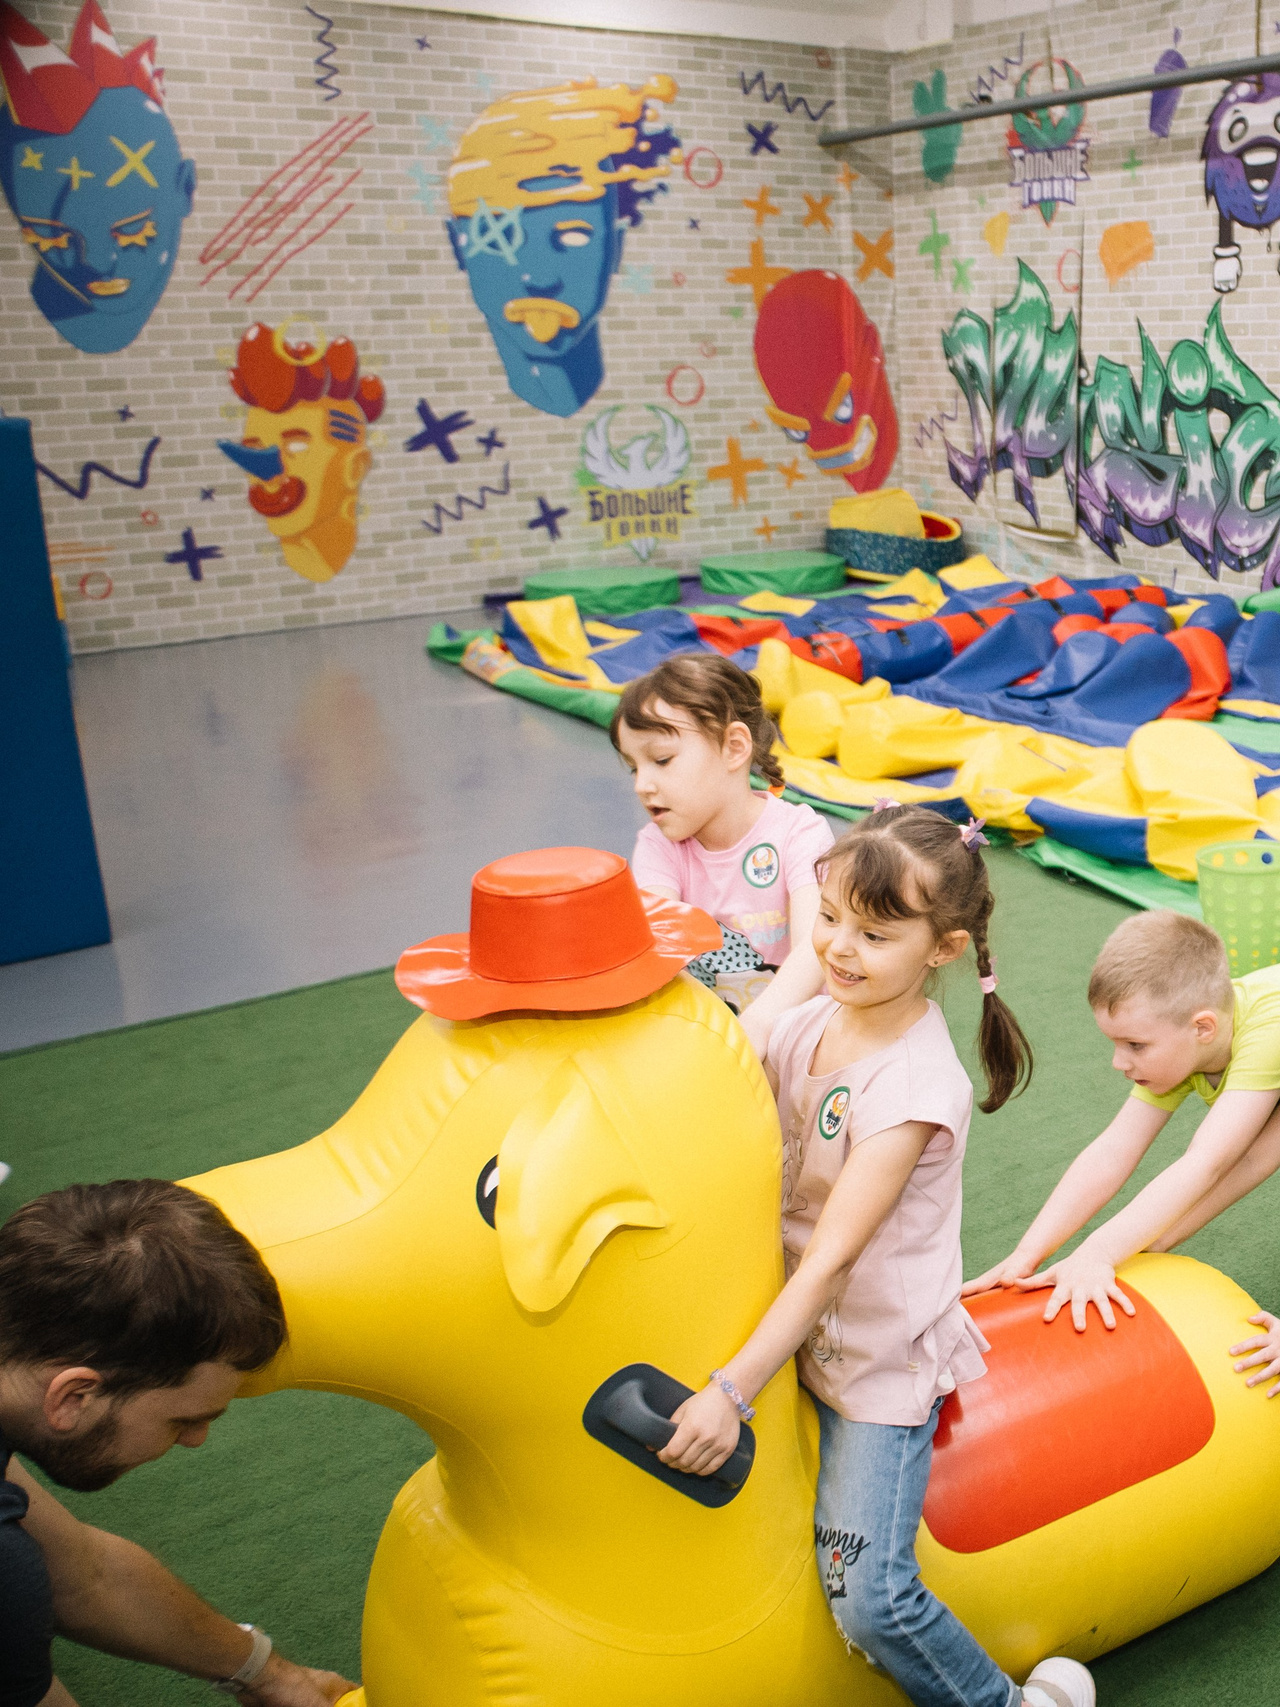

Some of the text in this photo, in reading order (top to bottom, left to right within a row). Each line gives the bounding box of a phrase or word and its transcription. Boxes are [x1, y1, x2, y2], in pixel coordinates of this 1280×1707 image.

[1009, 141, 1089, 185] БОЛЬШИЕ
[588, 484, 692, 521] БОЛЬШИЕ
[731, 910, 788, 930] LOVEL
